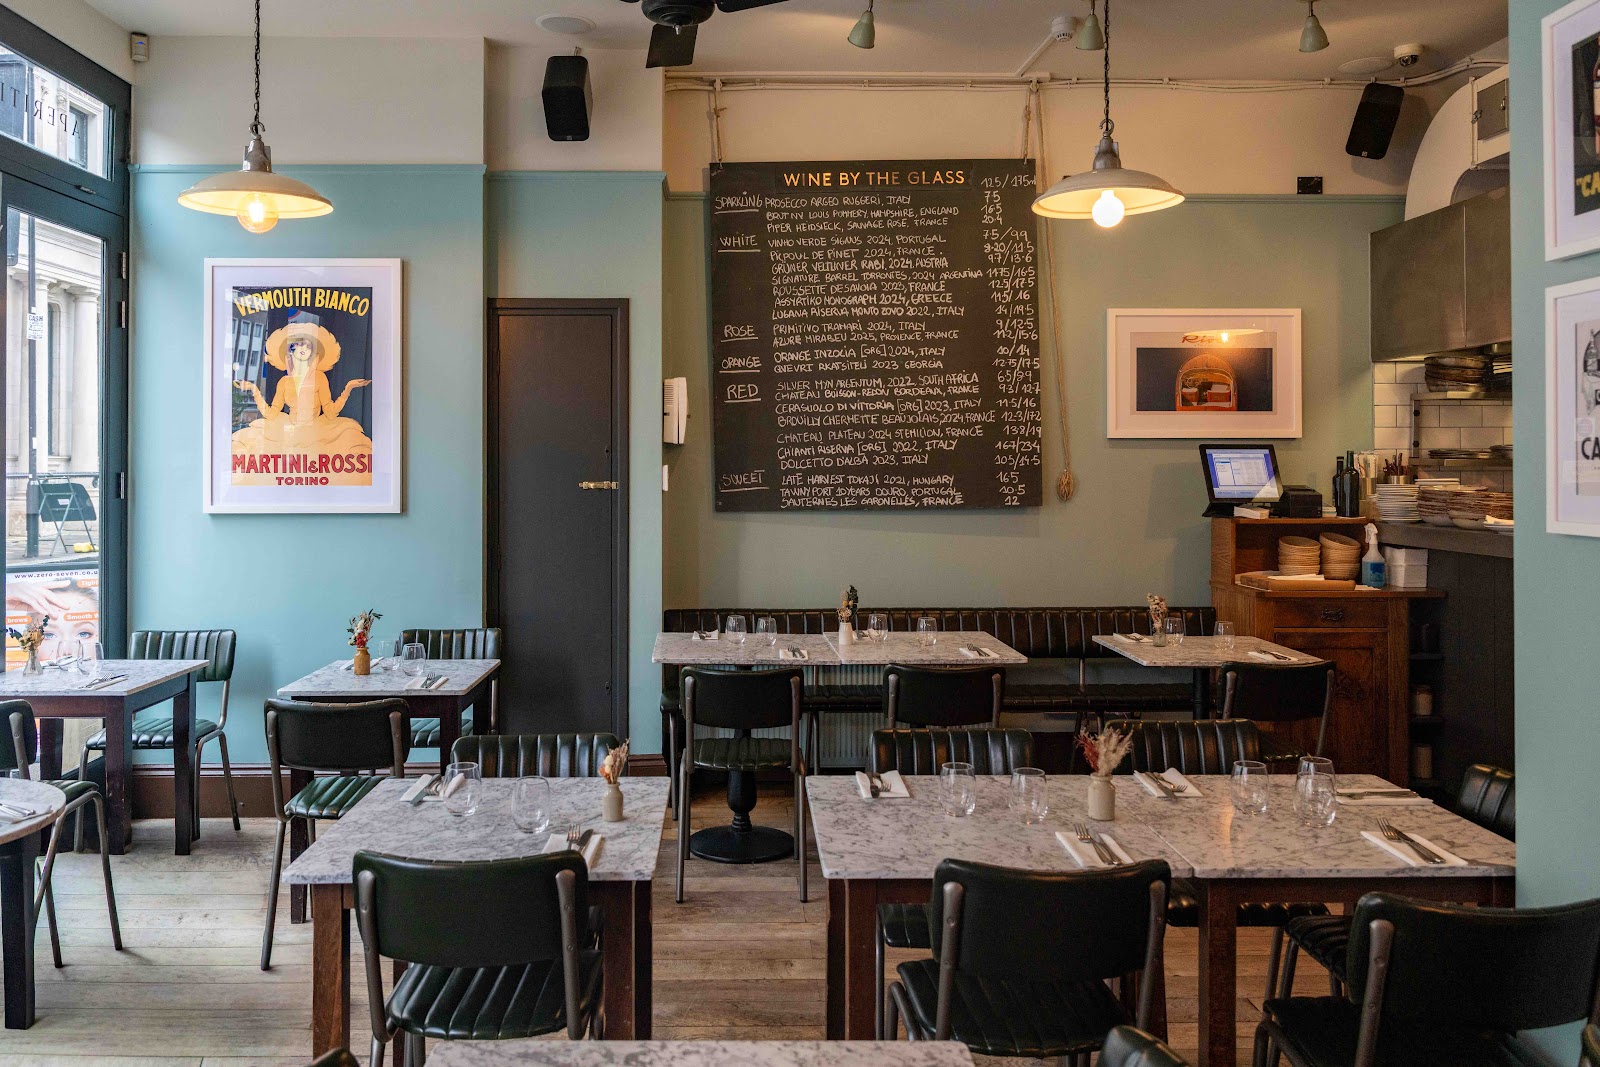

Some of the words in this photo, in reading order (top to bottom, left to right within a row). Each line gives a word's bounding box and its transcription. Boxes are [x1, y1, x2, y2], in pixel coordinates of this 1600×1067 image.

[783, 173, 831, 186] WINE
[839, 172, 860, 186] BY
[866, 172, 900, 185] THE
[908, 171, 965, 184] GLASS
[765, 197, 807, 209] PROSECCO
[811, 196, 839, 206] ARGEO
[887, 195, 911, 205] ITALY
[766, 212, 789, 221] BRUT
[809, 211, 829, 219] LOUIS
[920, 207, 959, 216] ENGLAND
[767, 223, 792, 233] PIPER
[847, 219, 884, 230] SAUVAGE
[914, 218, 948, 227] FRANCE
[720, 234, 758, 247] WHITE
[768, 239, 794, 247] VINHO
[796, 238, 826, 246] VERDE
[896, 235, 946, 244] PORTUGAL
[812, 251, 824, 260] DE
[827, 248, 859, 258] PINET
[897, 247, 935, 256] FRANCE
[915, 258, 949, 268] AUSTRIA
[772, 274, 820, 285] SIGNATURE
[825, 273, 859, 282] BARREL
[912, 271, 935, 280] 2024
[940, 268, 983, 279] ARGENTINA
[773, 285, 827, 296] ROUSSETTE
[908, 281, 945, 291] FRANCE
[234, 287, 312, 316] VERMOUTH
[315, 288, 369, 316] BIANCO
[775, 296, 822, 307] ASSYRTIKO
[824, 294, 876, 305] MONOGRAPH
[911, 293, 952, 305] GREECE
[773, 309, 808, 320] LUGANA
[811, 307, 849, 316] RISERVA
[936, 307, 965, 316] ITALY
[724, 325, 755, 337] ROSE
[773, 323, 819, 336] PRIMITIVO
[899, 322, 925, 330] ITALY
[773, 337, 801, 347] AZURE
[925, 330, 959, 340] FRANCE
[774, 351, 811, 363] ORANGE
[920, 346, 945, 357] ITALY
[722, 356, 762, 369] ORANGE
[872, 360, 899, 369] 2023
[905, 358, 943, 369] GEORGIA
[777, 380, 810, 391] SILVER
[815, 380, 834, 389] MYN
[918, 375, 944, 386] SOUTH
[945, 370, 979, 384] AFRICA
[727, 384, 759, 399] RED
[775, 391, 820, 401] CHATEAU
[947, 385, 979, 394] FRANCE
[775, 403, 834, 414] CERASUOLO
[837, 403, 847, 411] DI
[850, 399, 895, 411] VITTORIA
[954, 398, 982, 410] ITALY
[778, 414, 821, 427] BROUILLY
[823, 413, 879, 426] CHERMETTE
[966, 410, 996, 422] FRANCE
[777, 432, 823, 444] CHATEAU
[829, 429, 865, 440] PLATEAU
[868, 429, 892, 439] 2024
[946, 425, 983, 437] FRANCE
[778, 446, 815, 459] CHIANTI
[818, 443, 854, 455] RISERVA
[925, 439, 958, 450] ITALY
[781, 458, 833, 470] DOLCETTO
[902, 453, 928, 464] ITALY
[276, 477, 329, 485] TORINO
[722, 470, 765, 486] SWEET
[782, 473, 803, 485] LATE
[808, 474, 845, 485] HARVEST
[913, 475, 954, 486] HUNGARY
[780, 486, 810, 497] TAWNY
[812, 487, 834, 496] PORT
[912, 487, 962, 496] PORTUGAL
[781, 497, 838, 508] SAUTERNES
[840, 497, 858, 506] LES
[922, 495, 964, 506] FRANCE
[1005, 496, 1020, 505] 12
